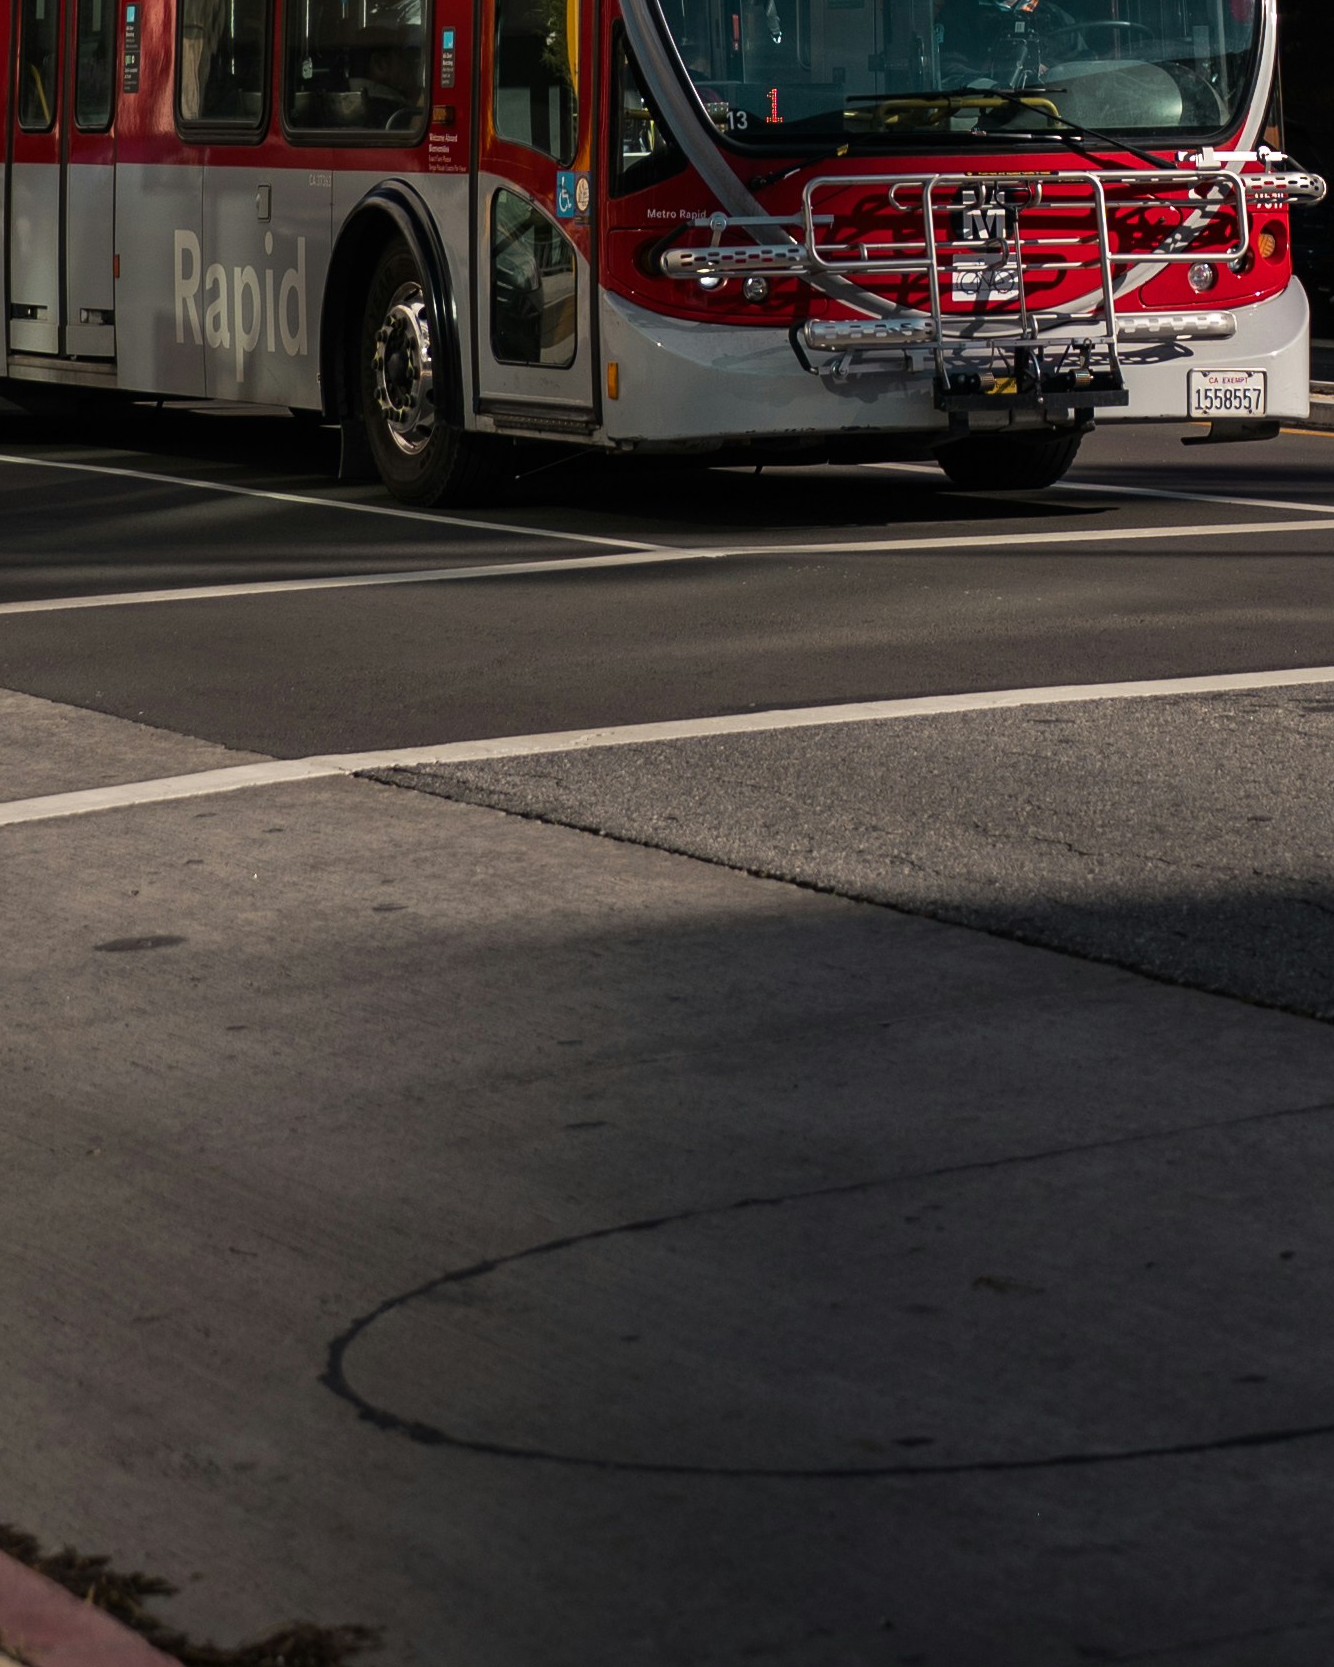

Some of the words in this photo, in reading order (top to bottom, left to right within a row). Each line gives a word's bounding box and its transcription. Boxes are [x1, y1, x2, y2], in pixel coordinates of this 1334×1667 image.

[726, 110, 748, 130] 13
[647, 209, 677, 218] Metro
[679, 209, 706, 220] Rapid
[174, 229, 308, 383] Rapid
[1194, 388, 1262, 410] 1558557
